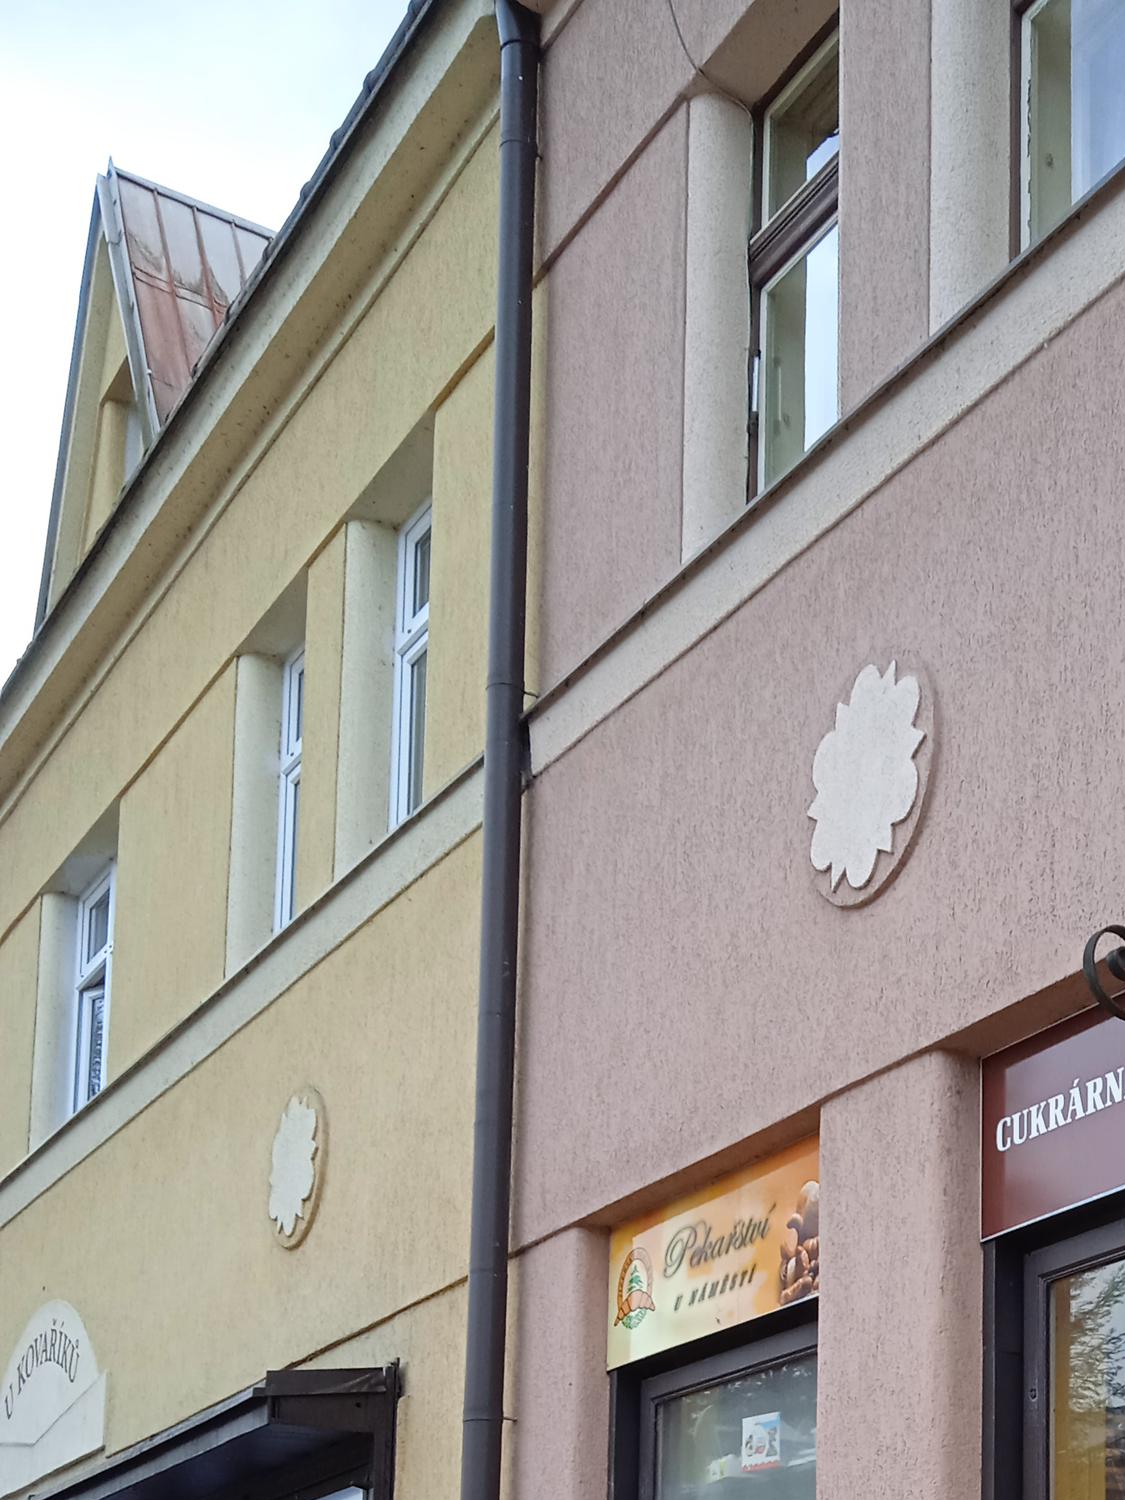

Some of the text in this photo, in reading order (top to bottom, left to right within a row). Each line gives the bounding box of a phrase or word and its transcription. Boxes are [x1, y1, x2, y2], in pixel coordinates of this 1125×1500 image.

[663, 1202, 777, 1278] Pekařství
[5, 1319, 80, 1420] U KOVAŘÍKŮ
